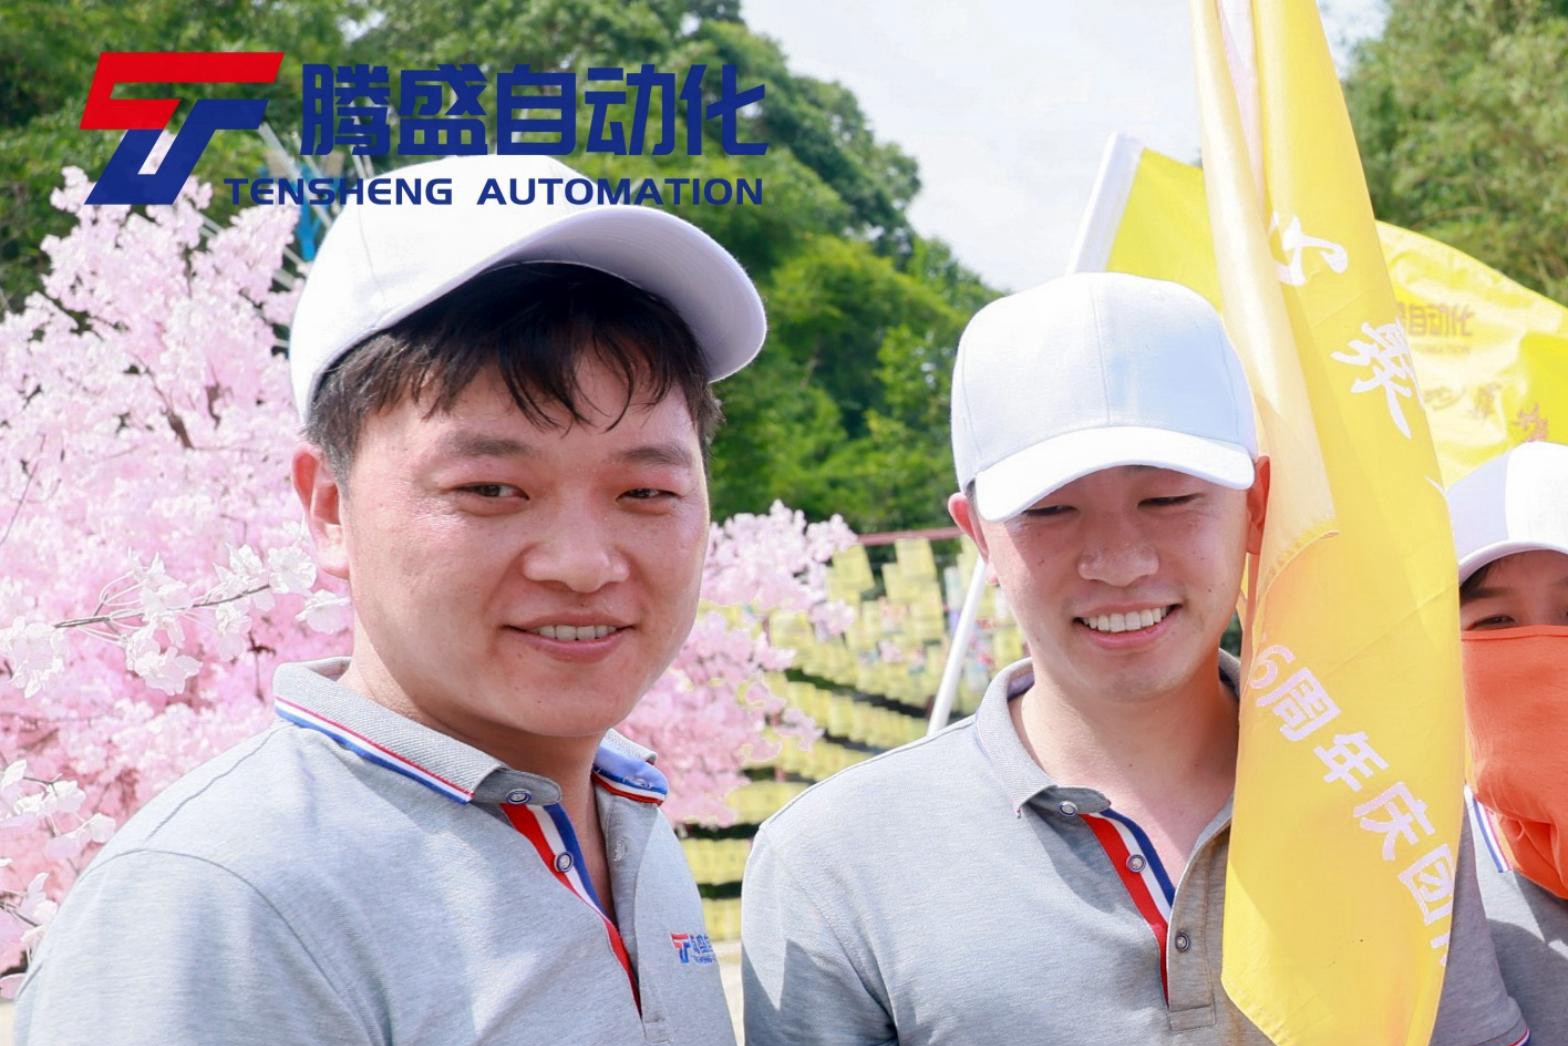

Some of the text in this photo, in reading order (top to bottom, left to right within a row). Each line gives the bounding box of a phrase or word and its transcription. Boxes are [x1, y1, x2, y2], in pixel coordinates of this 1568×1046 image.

[1399, 302, 1475, 338] 自动化
[1247, 643, 1455, 968] 6周年庆团
